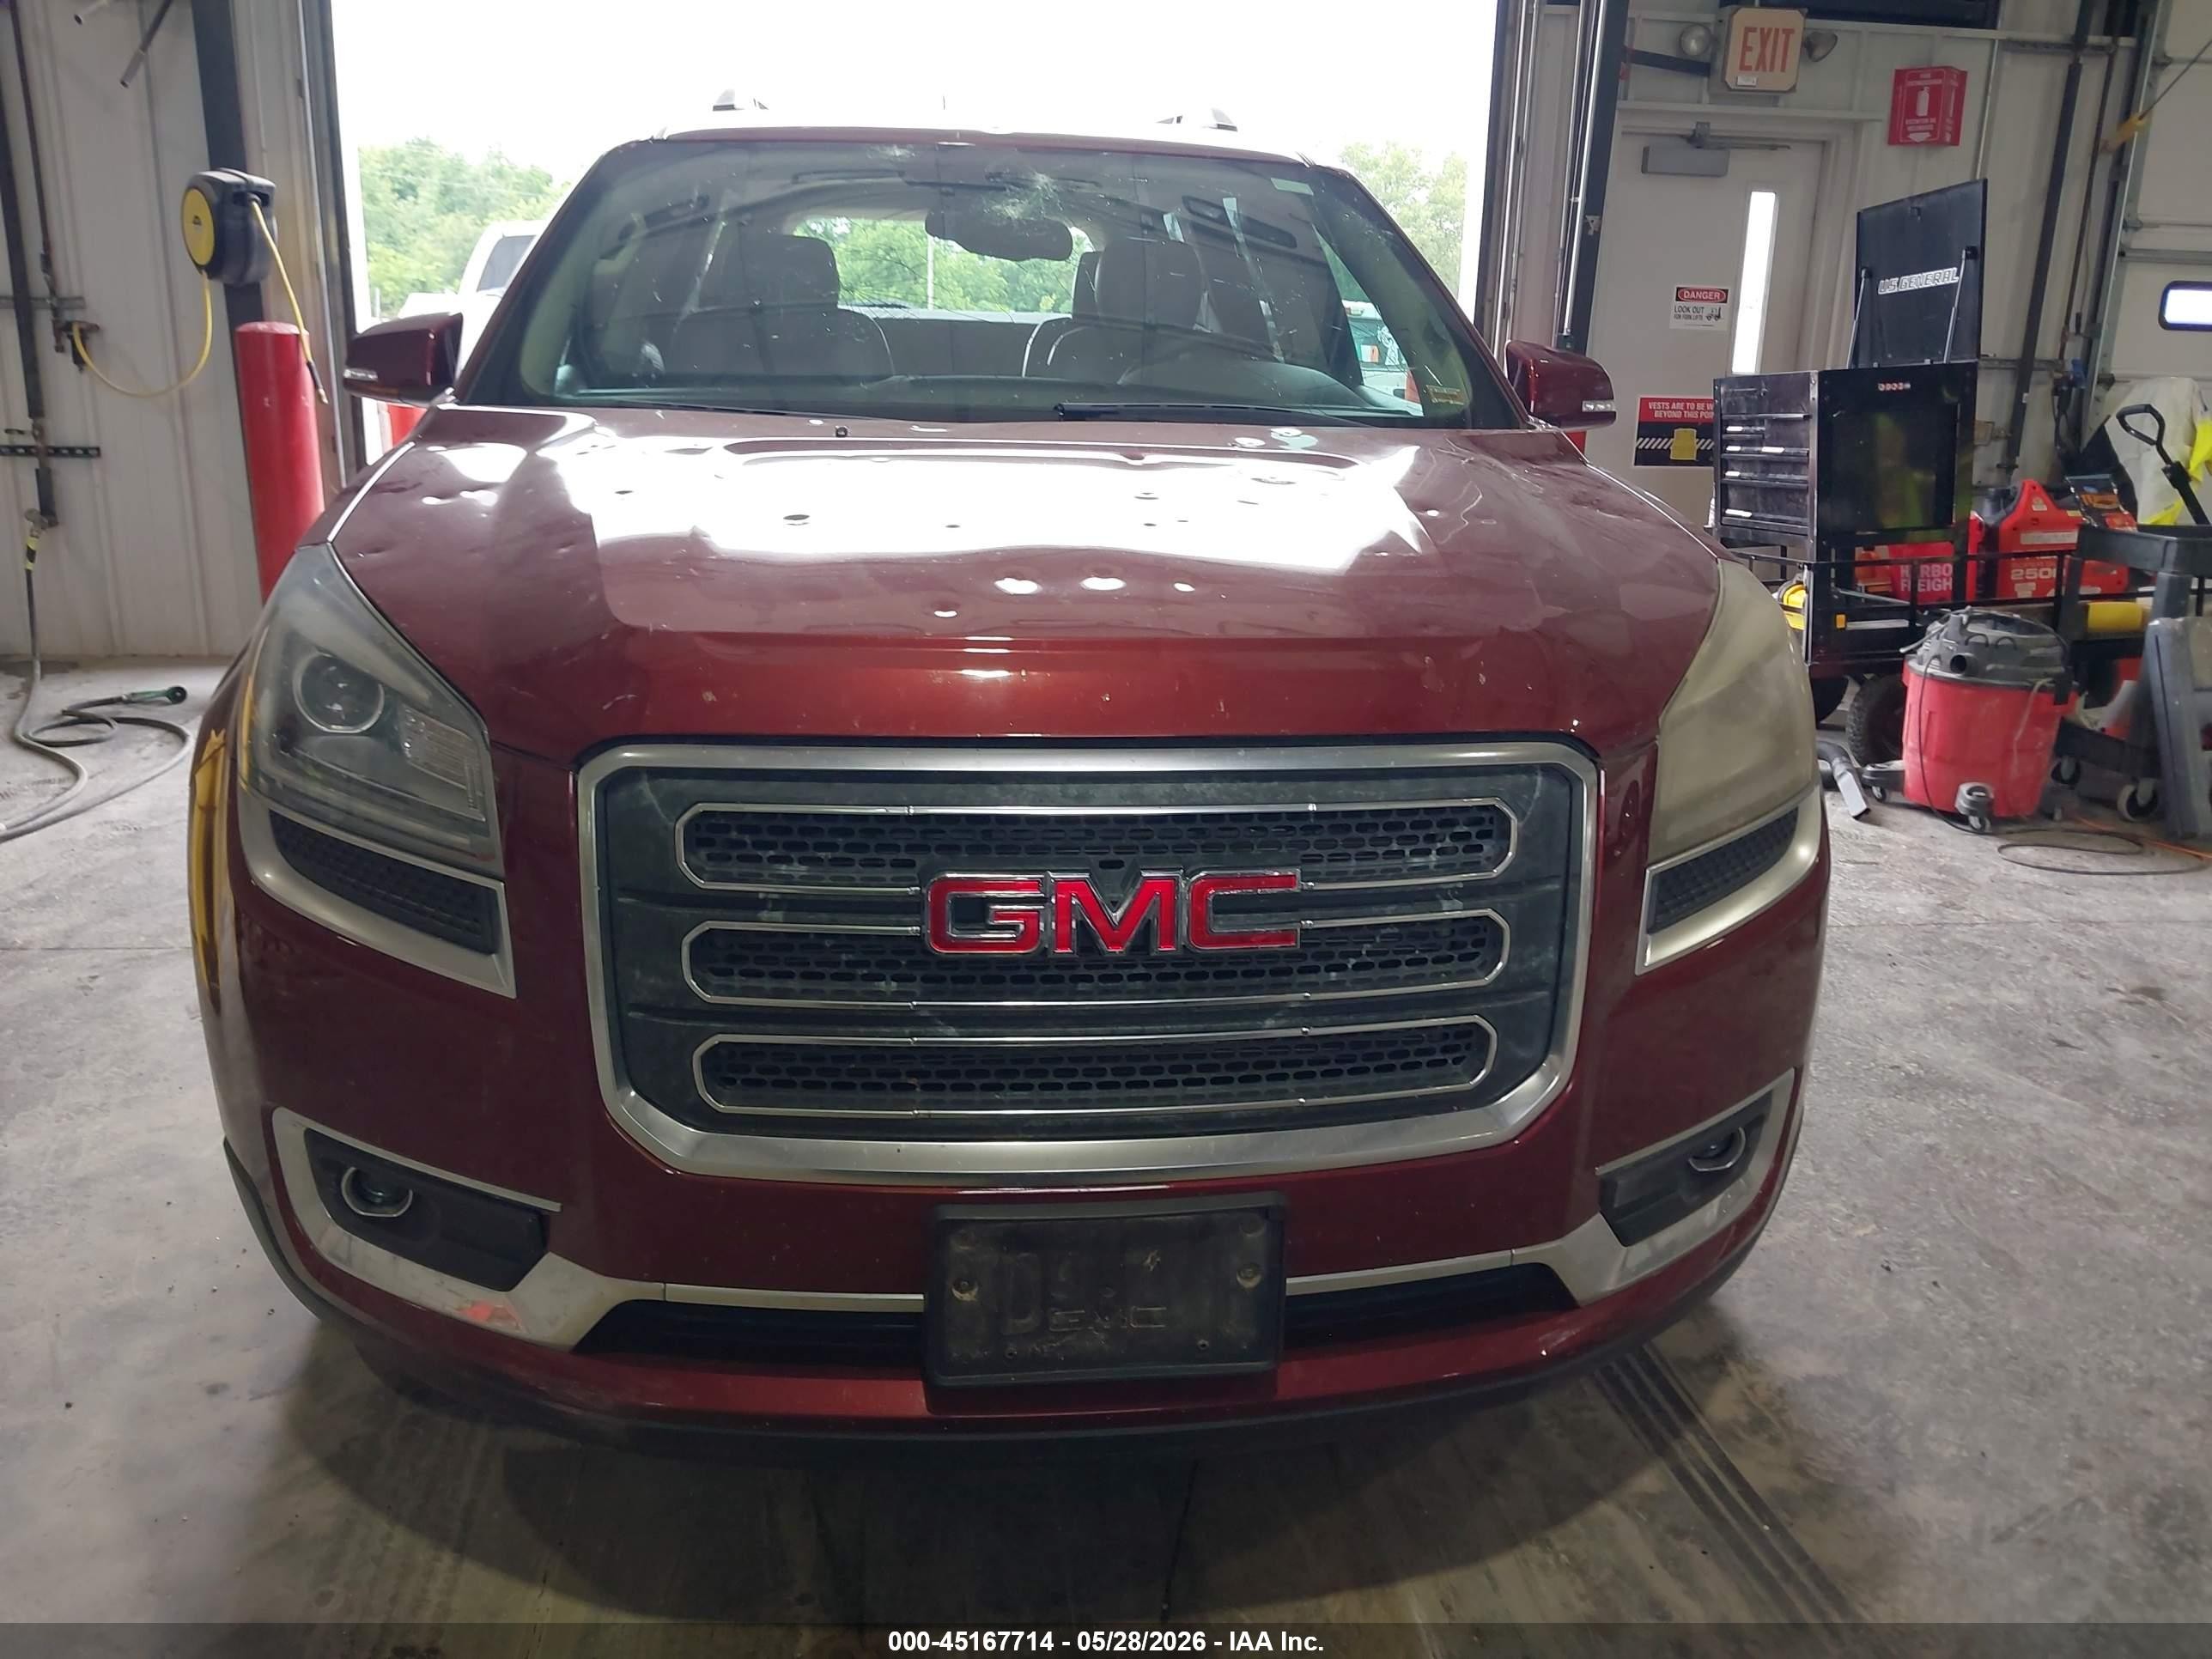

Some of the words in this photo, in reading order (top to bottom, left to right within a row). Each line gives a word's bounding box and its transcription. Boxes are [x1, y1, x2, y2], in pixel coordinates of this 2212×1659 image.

[1739, 27, 1795, 72] EXIT
[1878, 277, 1899, 295] US
[1899, 267, 1959, 291] GENERAL
[1683, 290, 1720, 300] DANGER
[1674, 305, 1691, 313] LOOK
[1692, 306, 1704, 314] OUT
[1649, 401, 1670, 410] VESTS
[1696, 402, 1705, 410] BE
[1654, 410, 1682, 418] BEYOND
[1900, 563, 1953, 578] HRBO
[927, 866, 1301, 955] GMC
